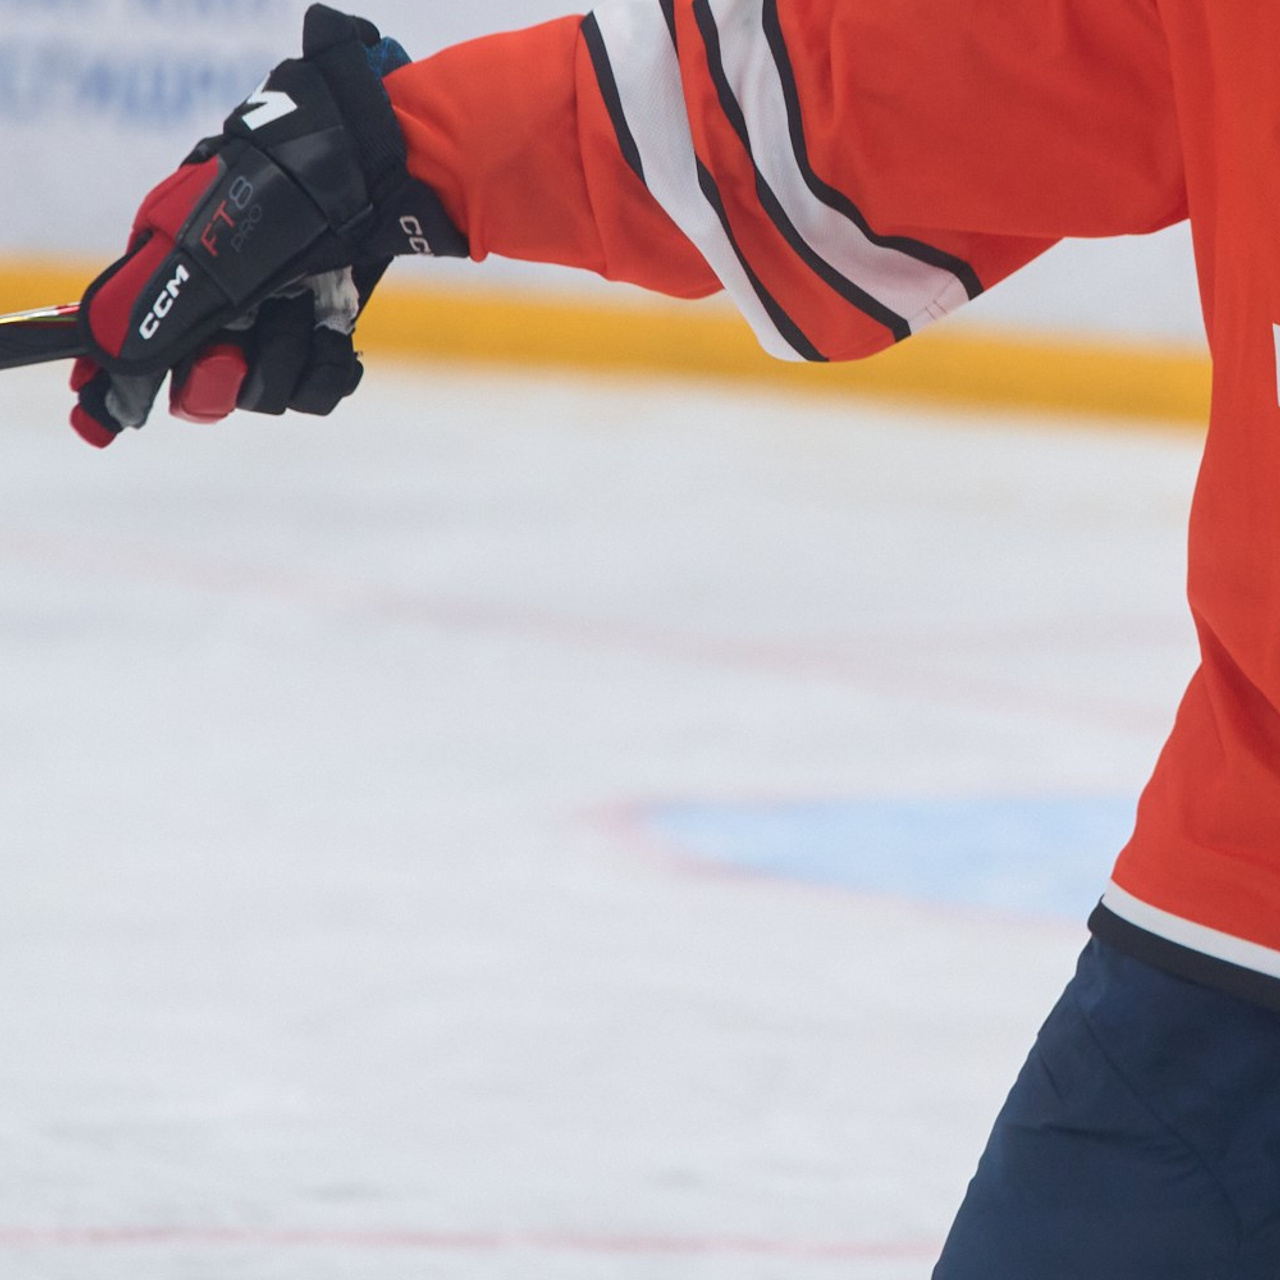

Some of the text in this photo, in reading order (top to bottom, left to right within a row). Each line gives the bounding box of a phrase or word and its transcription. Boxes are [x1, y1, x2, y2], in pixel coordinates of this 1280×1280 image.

[201, 175, 254, 258] FT8
[230, 204, 262, 254] PRO
[399, 215, 436, 258] CC
[139, 263, 190, 340] CCM
